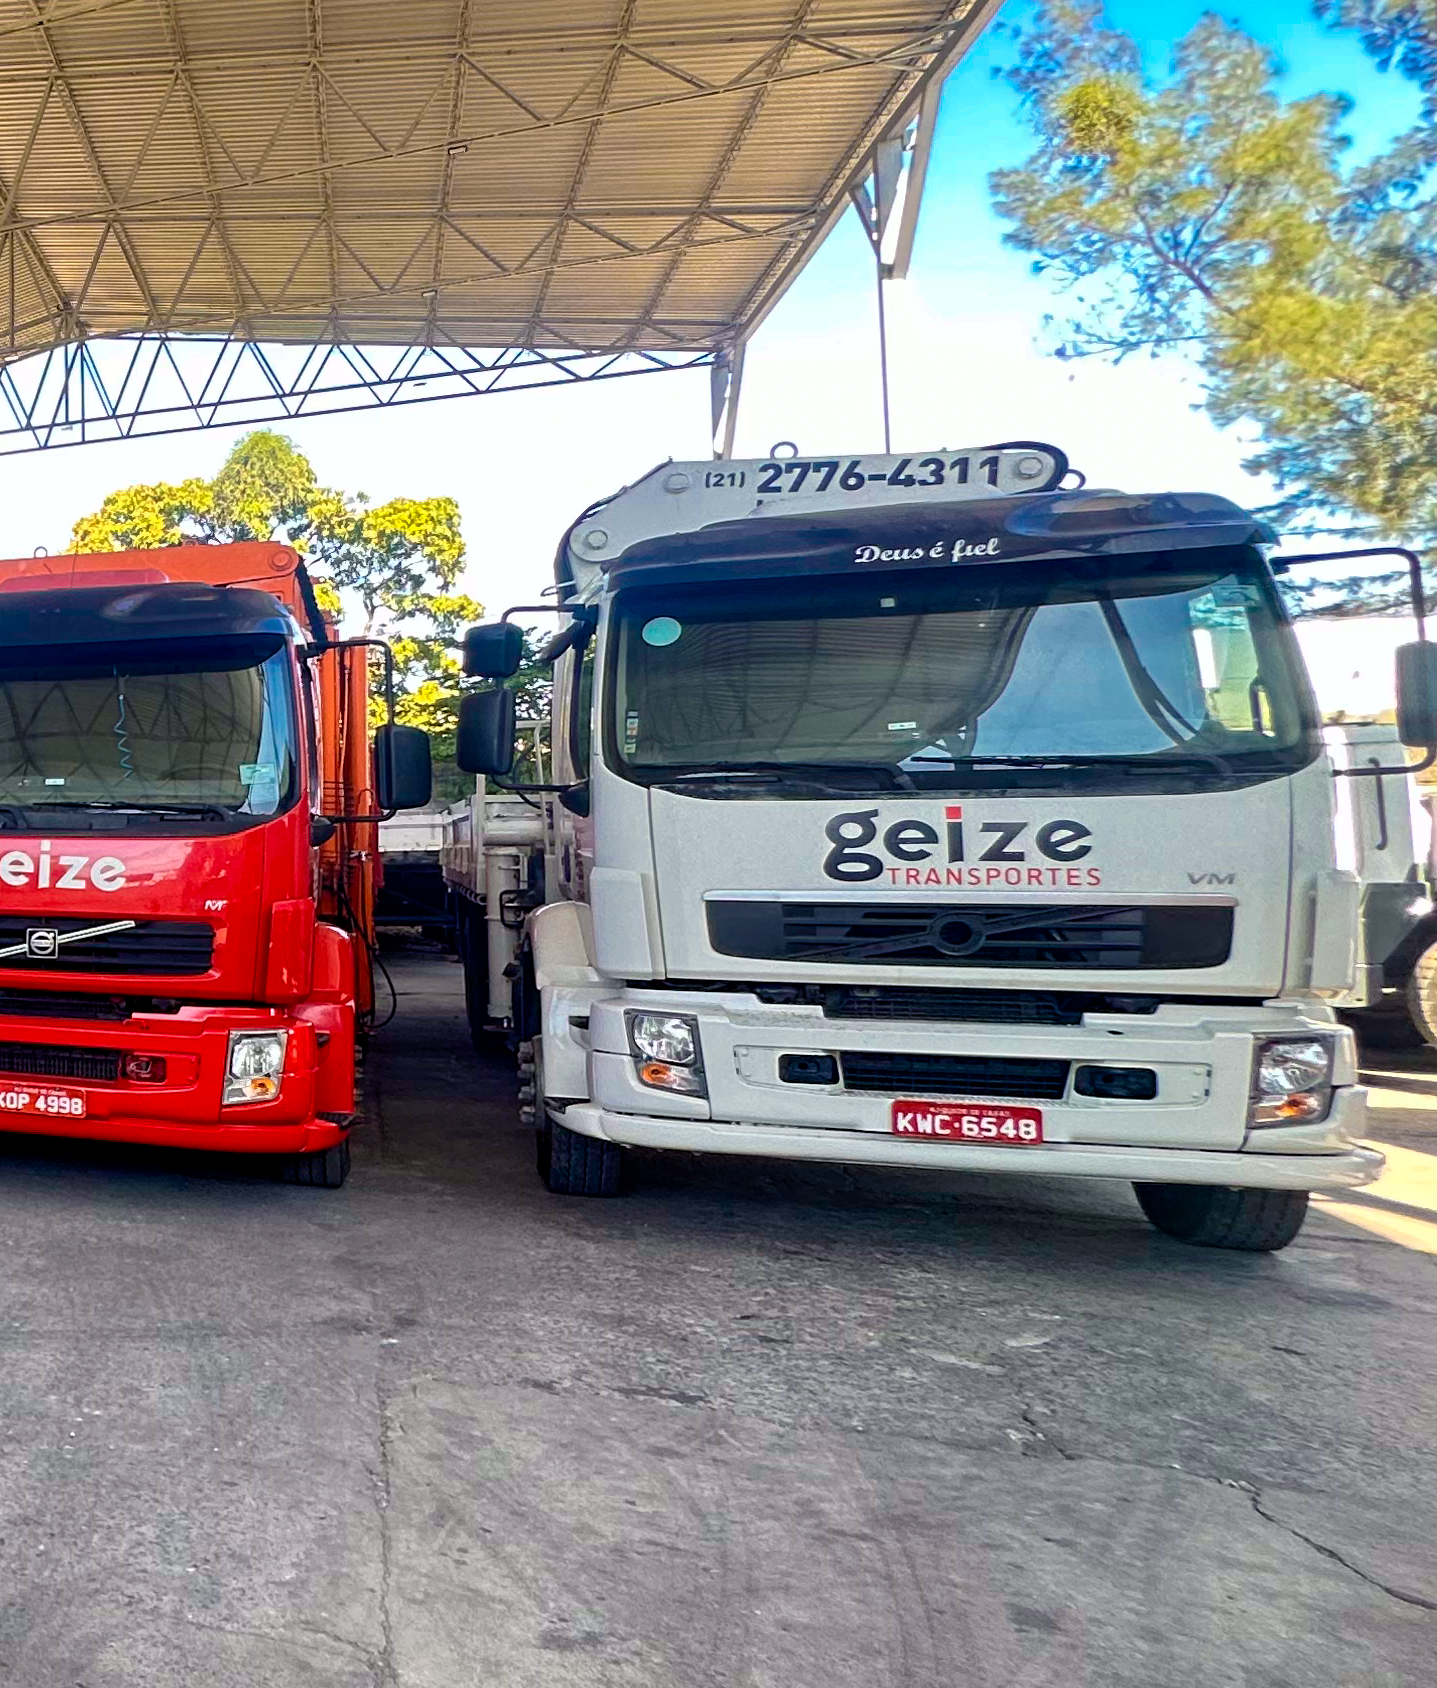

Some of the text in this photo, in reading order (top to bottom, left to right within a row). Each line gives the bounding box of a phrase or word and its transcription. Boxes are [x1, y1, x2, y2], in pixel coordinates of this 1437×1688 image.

[705, 456, 1000, 493] (21) 2776-4311
[854, 537, 1001, 563] Deus é fiel
[823, 805, 1093, 882] geize
[885, 867, 1102, 886] TRANSPORTES
[1187, 872, 1236, 885] VM
[35, 1095, 84, 1115] 4998
